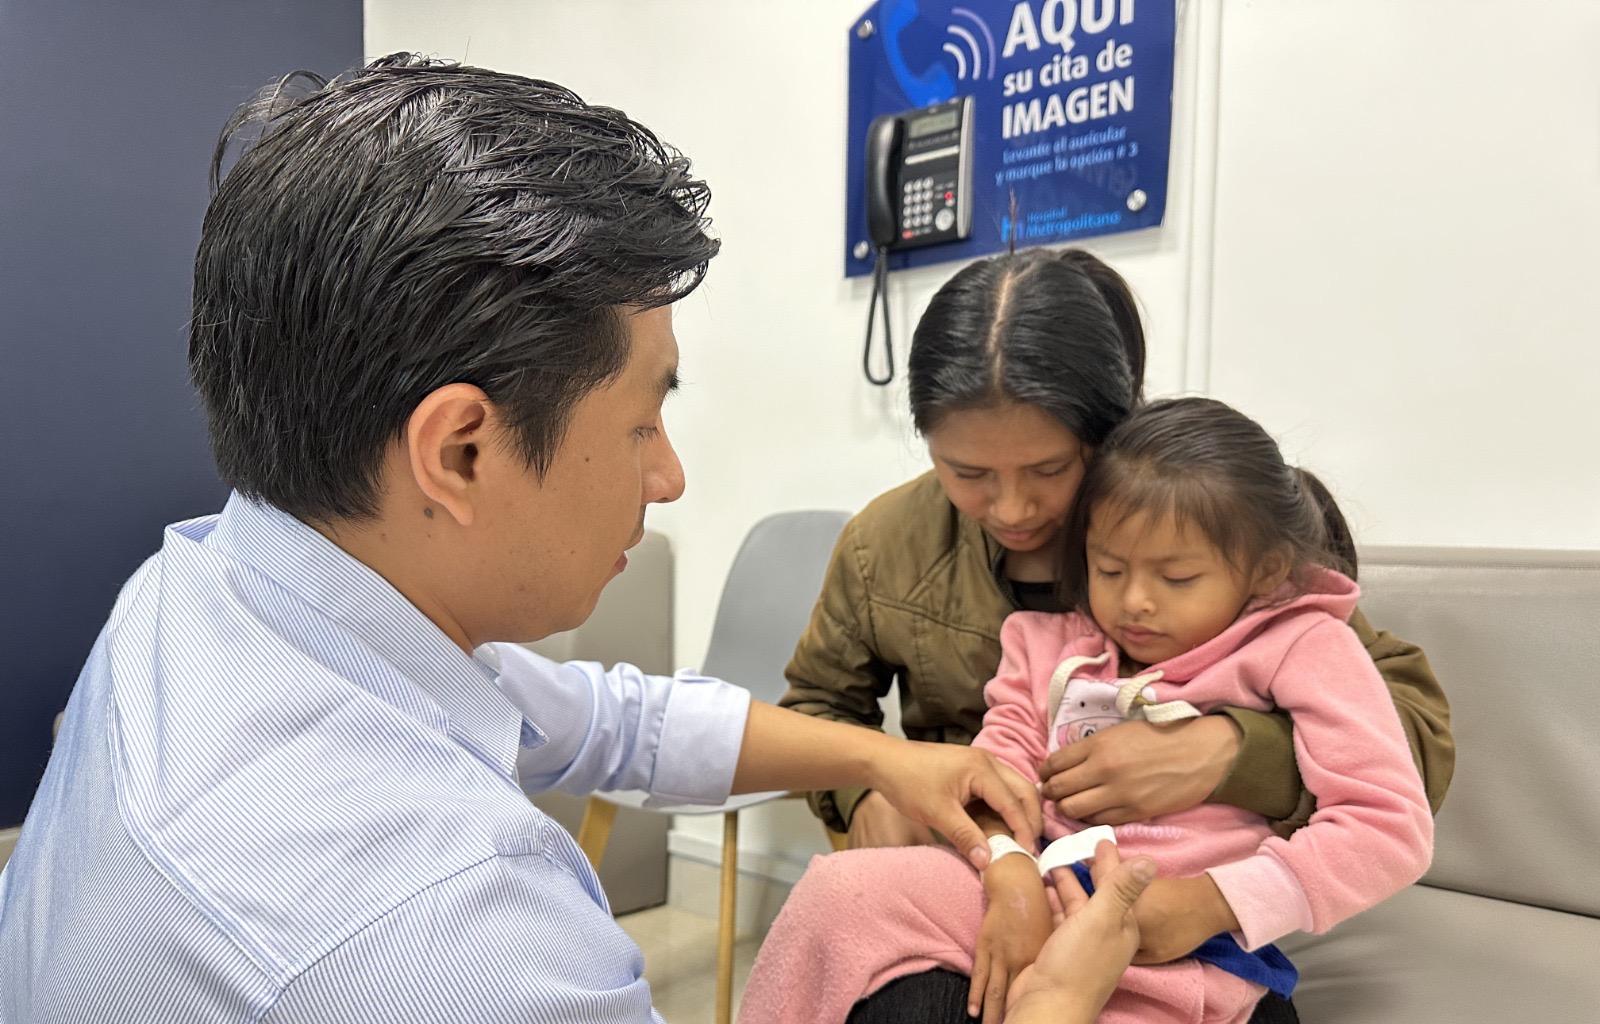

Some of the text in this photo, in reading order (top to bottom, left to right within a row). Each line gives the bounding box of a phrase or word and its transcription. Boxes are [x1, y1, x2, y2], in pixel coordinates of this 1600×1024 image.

[1003, 39, 1133, 97] su cita de
[1002, 75, 1135, 139] IMAGEN
[1068, 126, 1127, 150] auricular
[1005, 161, 1053, 180] marque
[1117, 144, 1126, 159] #
[1128, 141, 1138, 157] 3
[1026, 211, 1121, 238] Metropolitano
